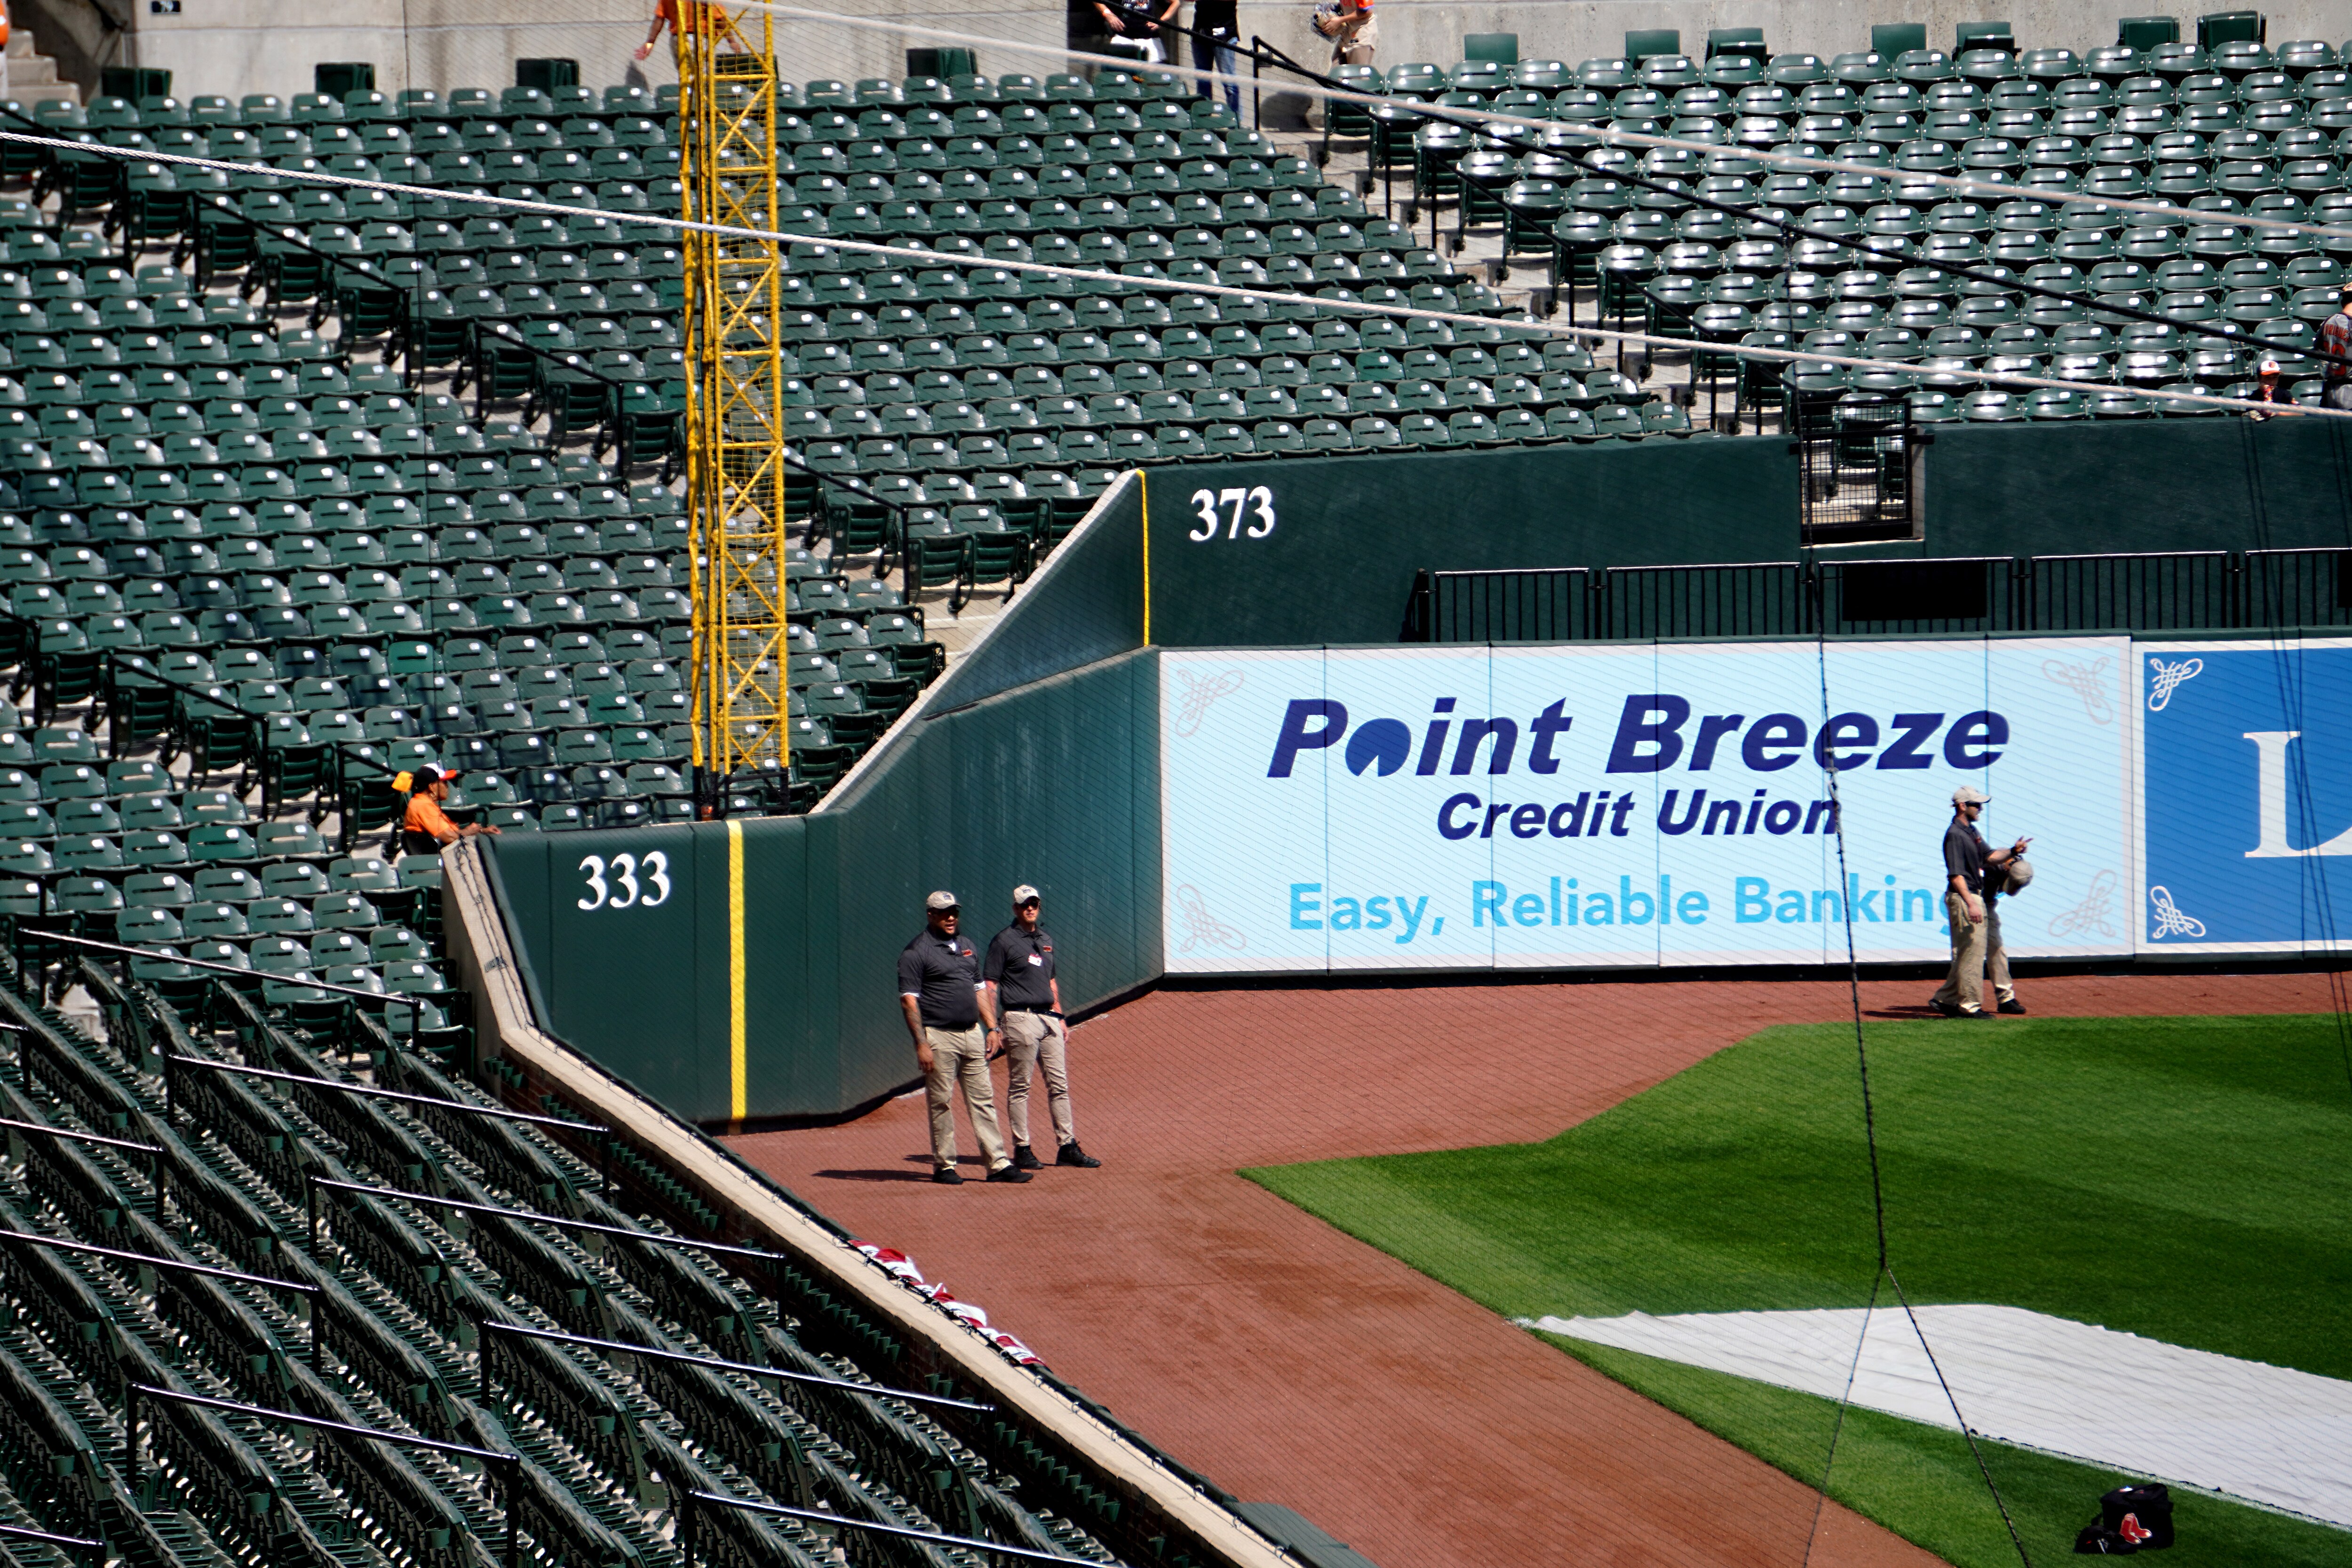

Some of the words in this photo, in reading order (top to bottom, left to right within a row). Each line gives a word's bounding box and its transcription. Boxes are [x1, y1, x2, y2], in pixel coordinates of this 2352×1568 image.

[1190, 486, 1274, 541] 373
[1267, 697, 1572, 778] Point
[1605, 693, 2009, 774] Breeze
[1438, 791, 1635, 841] Credit
[1657, 789, 1841, 836] Union
[578, 851, 670, 910] 333
[1289, 883, 1446, 945] Easy,
[1472, 874, 1709, 928] Reliable
[1734, 873, 1950, 936] Bankin
